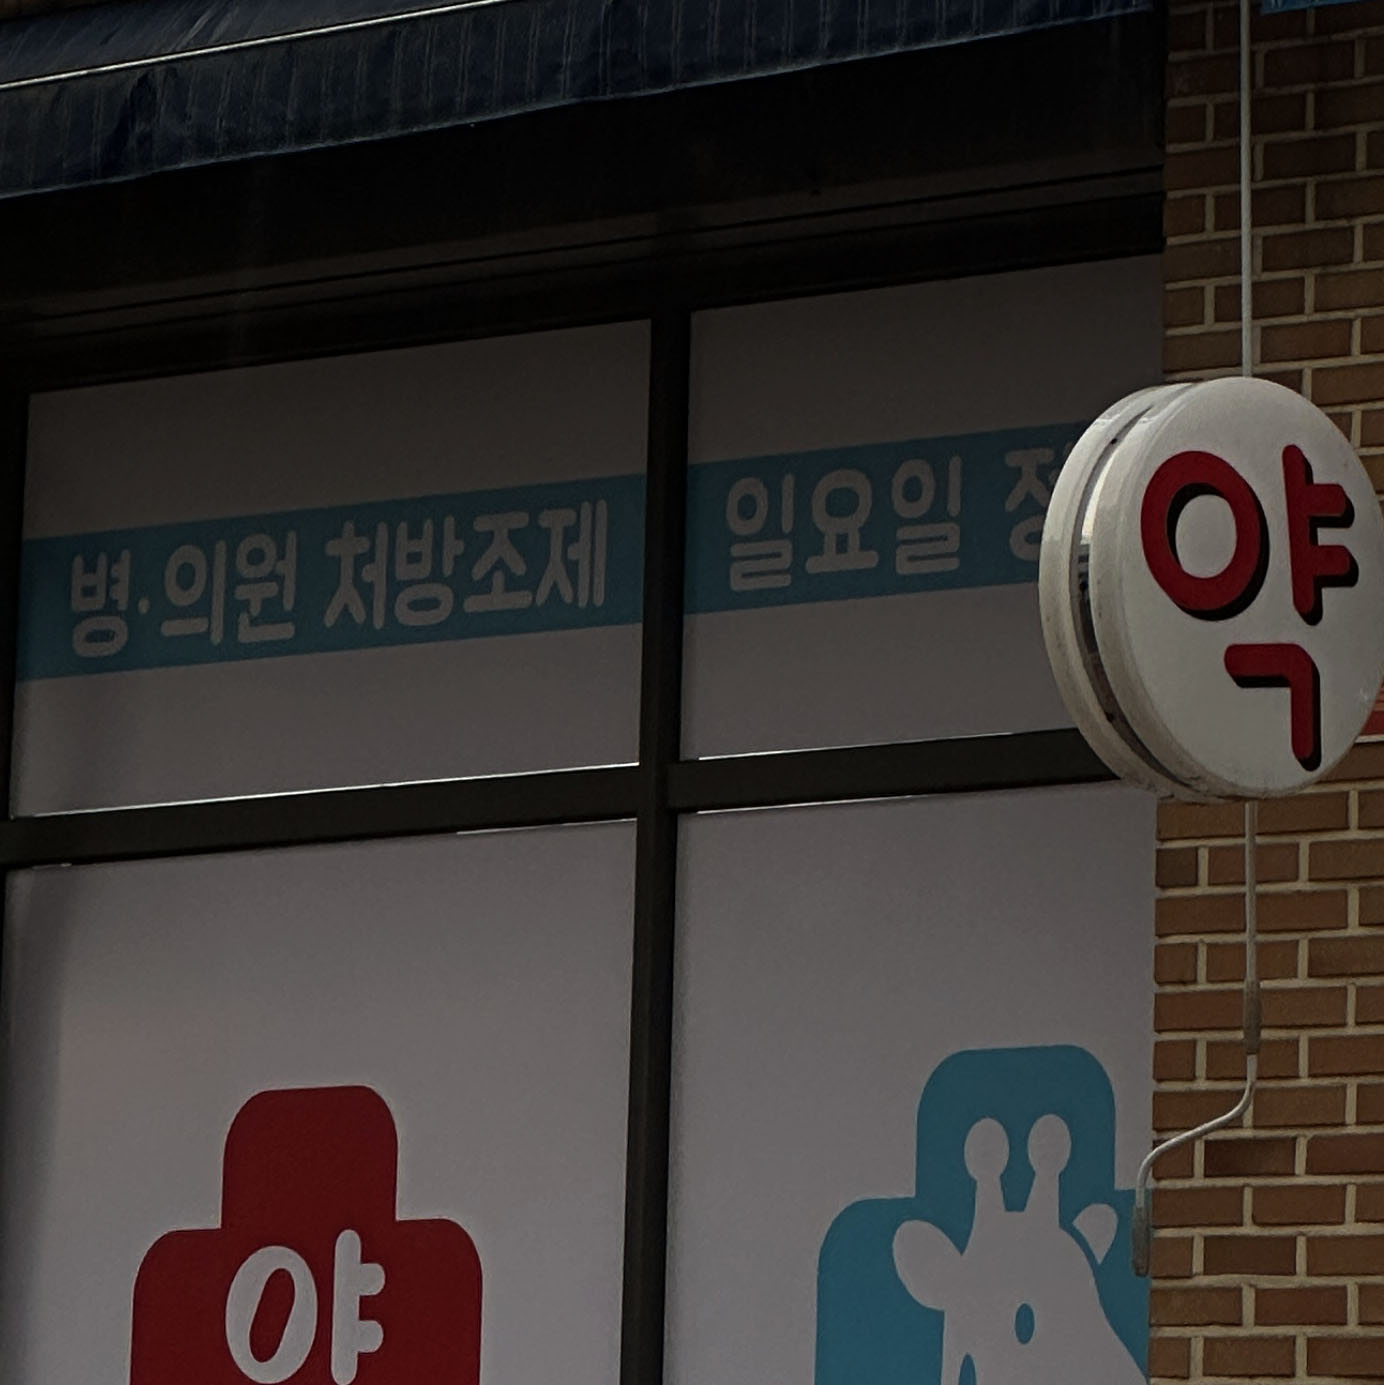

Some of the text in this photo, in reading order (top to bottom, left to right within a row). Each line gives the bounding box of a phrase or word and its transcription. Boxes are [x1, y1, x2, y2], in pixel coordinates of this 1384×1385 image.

[323, 499, 609, 630] 처방조제
[725, 455, 962, 592] 일요일
[1141, 444, 1359, 771] 약
